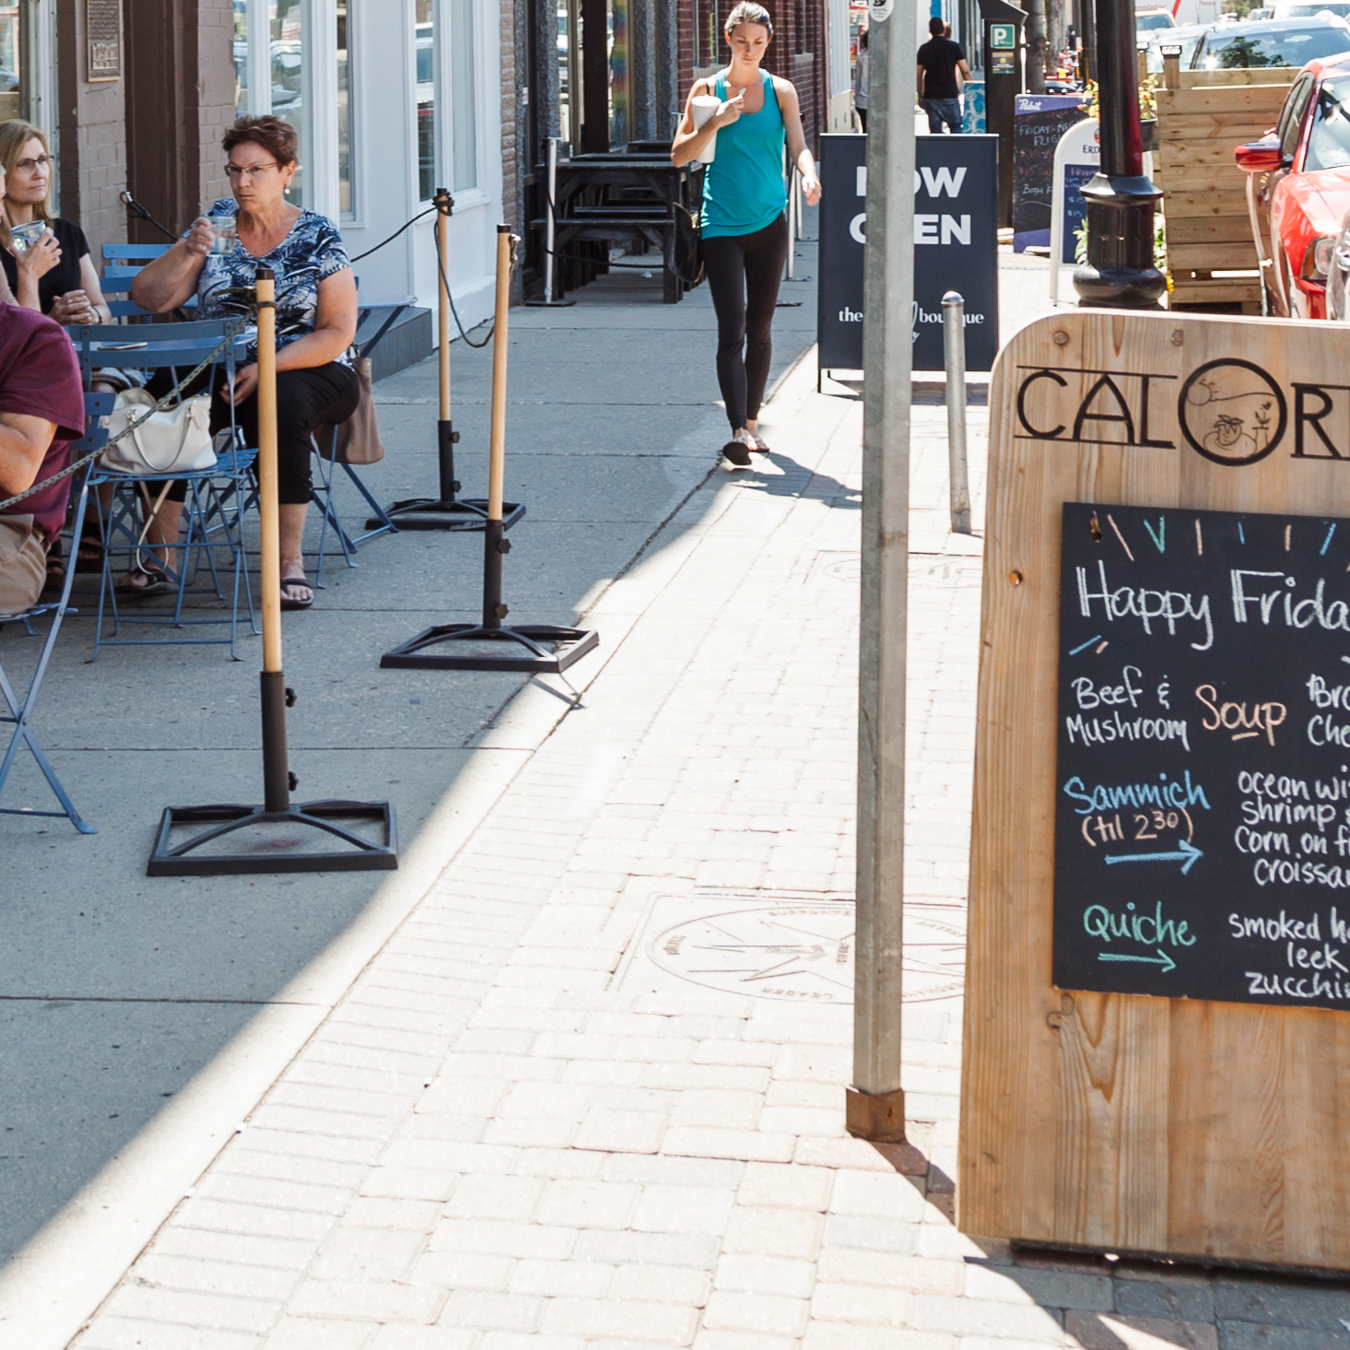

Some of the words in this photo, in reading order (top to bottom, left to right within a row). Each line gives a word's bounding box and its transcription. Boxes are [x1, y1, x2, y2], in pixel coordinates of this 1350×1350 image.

[993, 27, 1008, 46] P
[1019, 125, 1050, 137] FRIDAY
[1082, 144, 1101, 155] ERD
[838, 306, 864, 323] the
[1076, 560, 1213, 651] Happy
[1070, 665, 1143, 709] Beef
[1065, 711, 1191, 752] Mushroom
[1195, 684, 1287, 747] Soup
[1063, 769, 1212, 815] Sammich
[1237, 770, 1311, 801] ocean
[1241, 795, 1337, 833] shrimp
[1300, 830, 1328, 855] on
[1082, 900, 1197, 947] Quiche
[1227, 909, 1321, 941] smoked
[1286, 941, 1350, 973] leek
